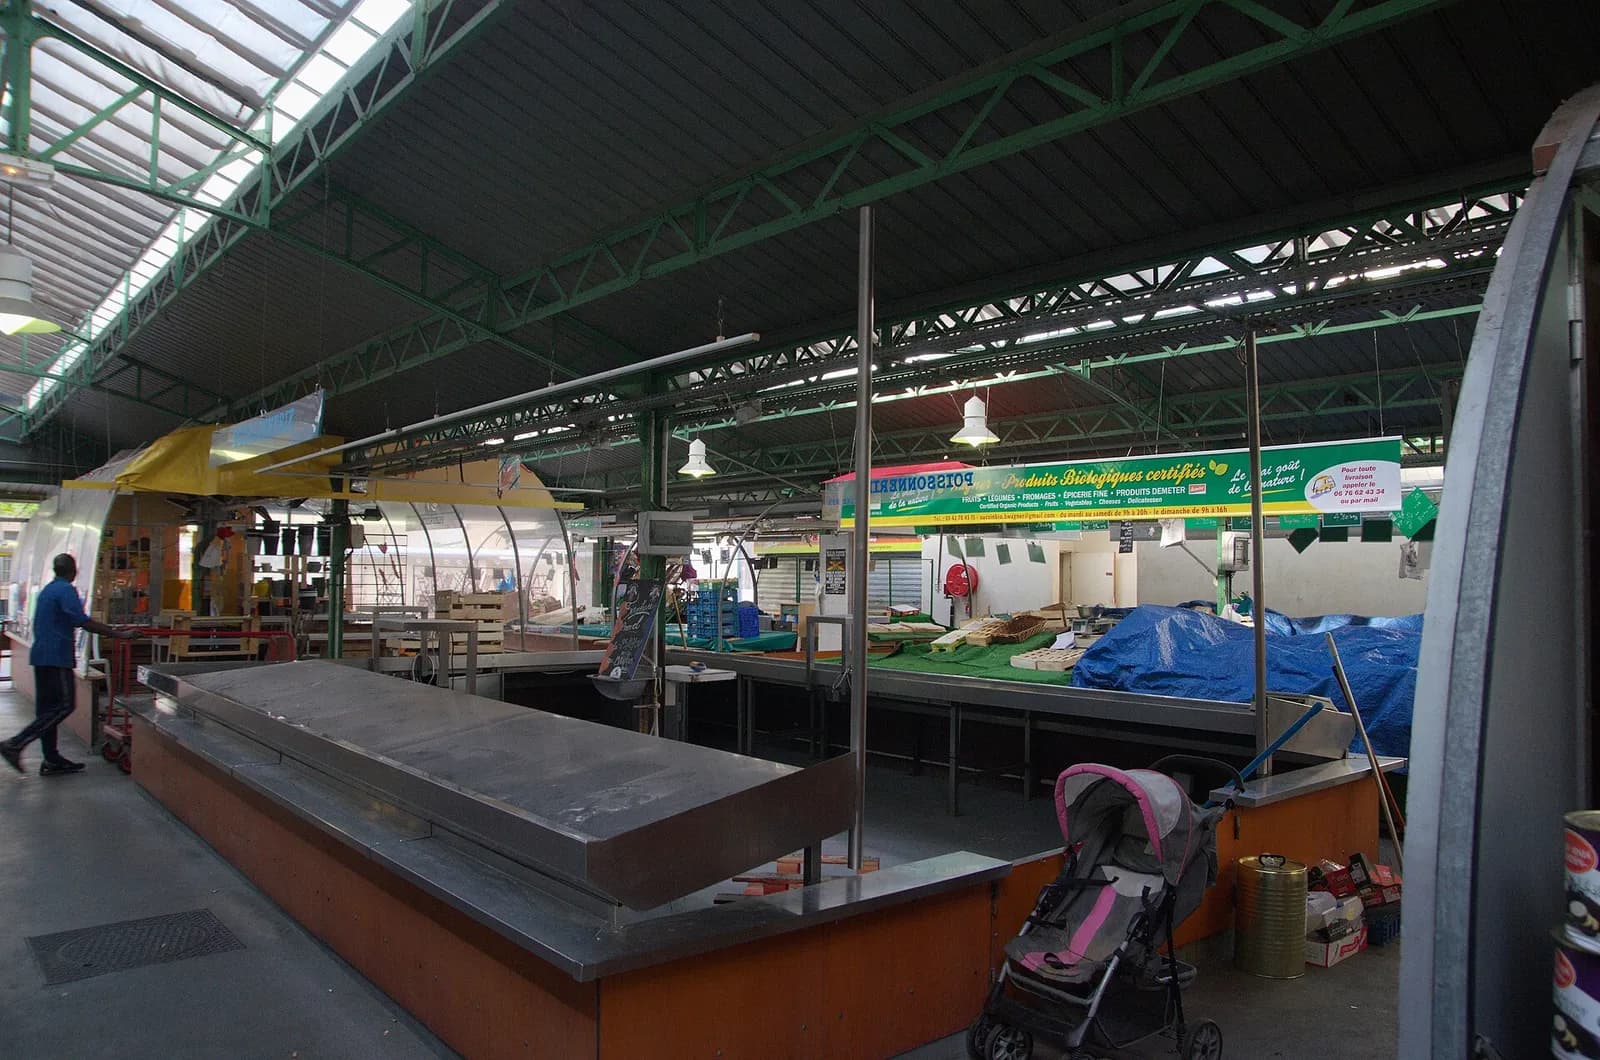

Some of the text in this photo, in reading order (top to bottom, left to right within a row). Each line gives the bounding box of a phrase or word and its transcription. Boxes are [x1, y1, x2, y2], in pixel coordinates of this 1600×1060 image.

[1002, 473, 1058, 489] Produits
[1060, 467, 1143, 489] Biologiques
[1146, 463, 1206, 485] certifiés
[1230, 469, 1246, 483] Le
[1275, 460, 1301, 477] goût
[1228, 484, 1241, 495] de
[1261, 475, 1296, 488] nature
[1342, 481, 1367, 490] appeler
[962, 494, 981, 504] FRUITS
[1022, 491, 1056, 501] FROMAGES
[1093, 489, 1108, 498] FINE
[1116, 487, 1151, 497] PRODUITS
[1151, 486, 1185, 496] DEMETER
[1351, 498, 1362, 506] par
[1362, 496, 1379, 504] mail
[1017, 501, 1039, 509] Products
[1065, 499, 1093, 508] Vegetables
[1093, 509, 1115, 517] samedi
[1153, 507, 1160, 515] le
[1161, 507, 1191, 515] dimanche
[1192, 506, 1200, 514] de
[1201, 506, 1210, 514] 9h
